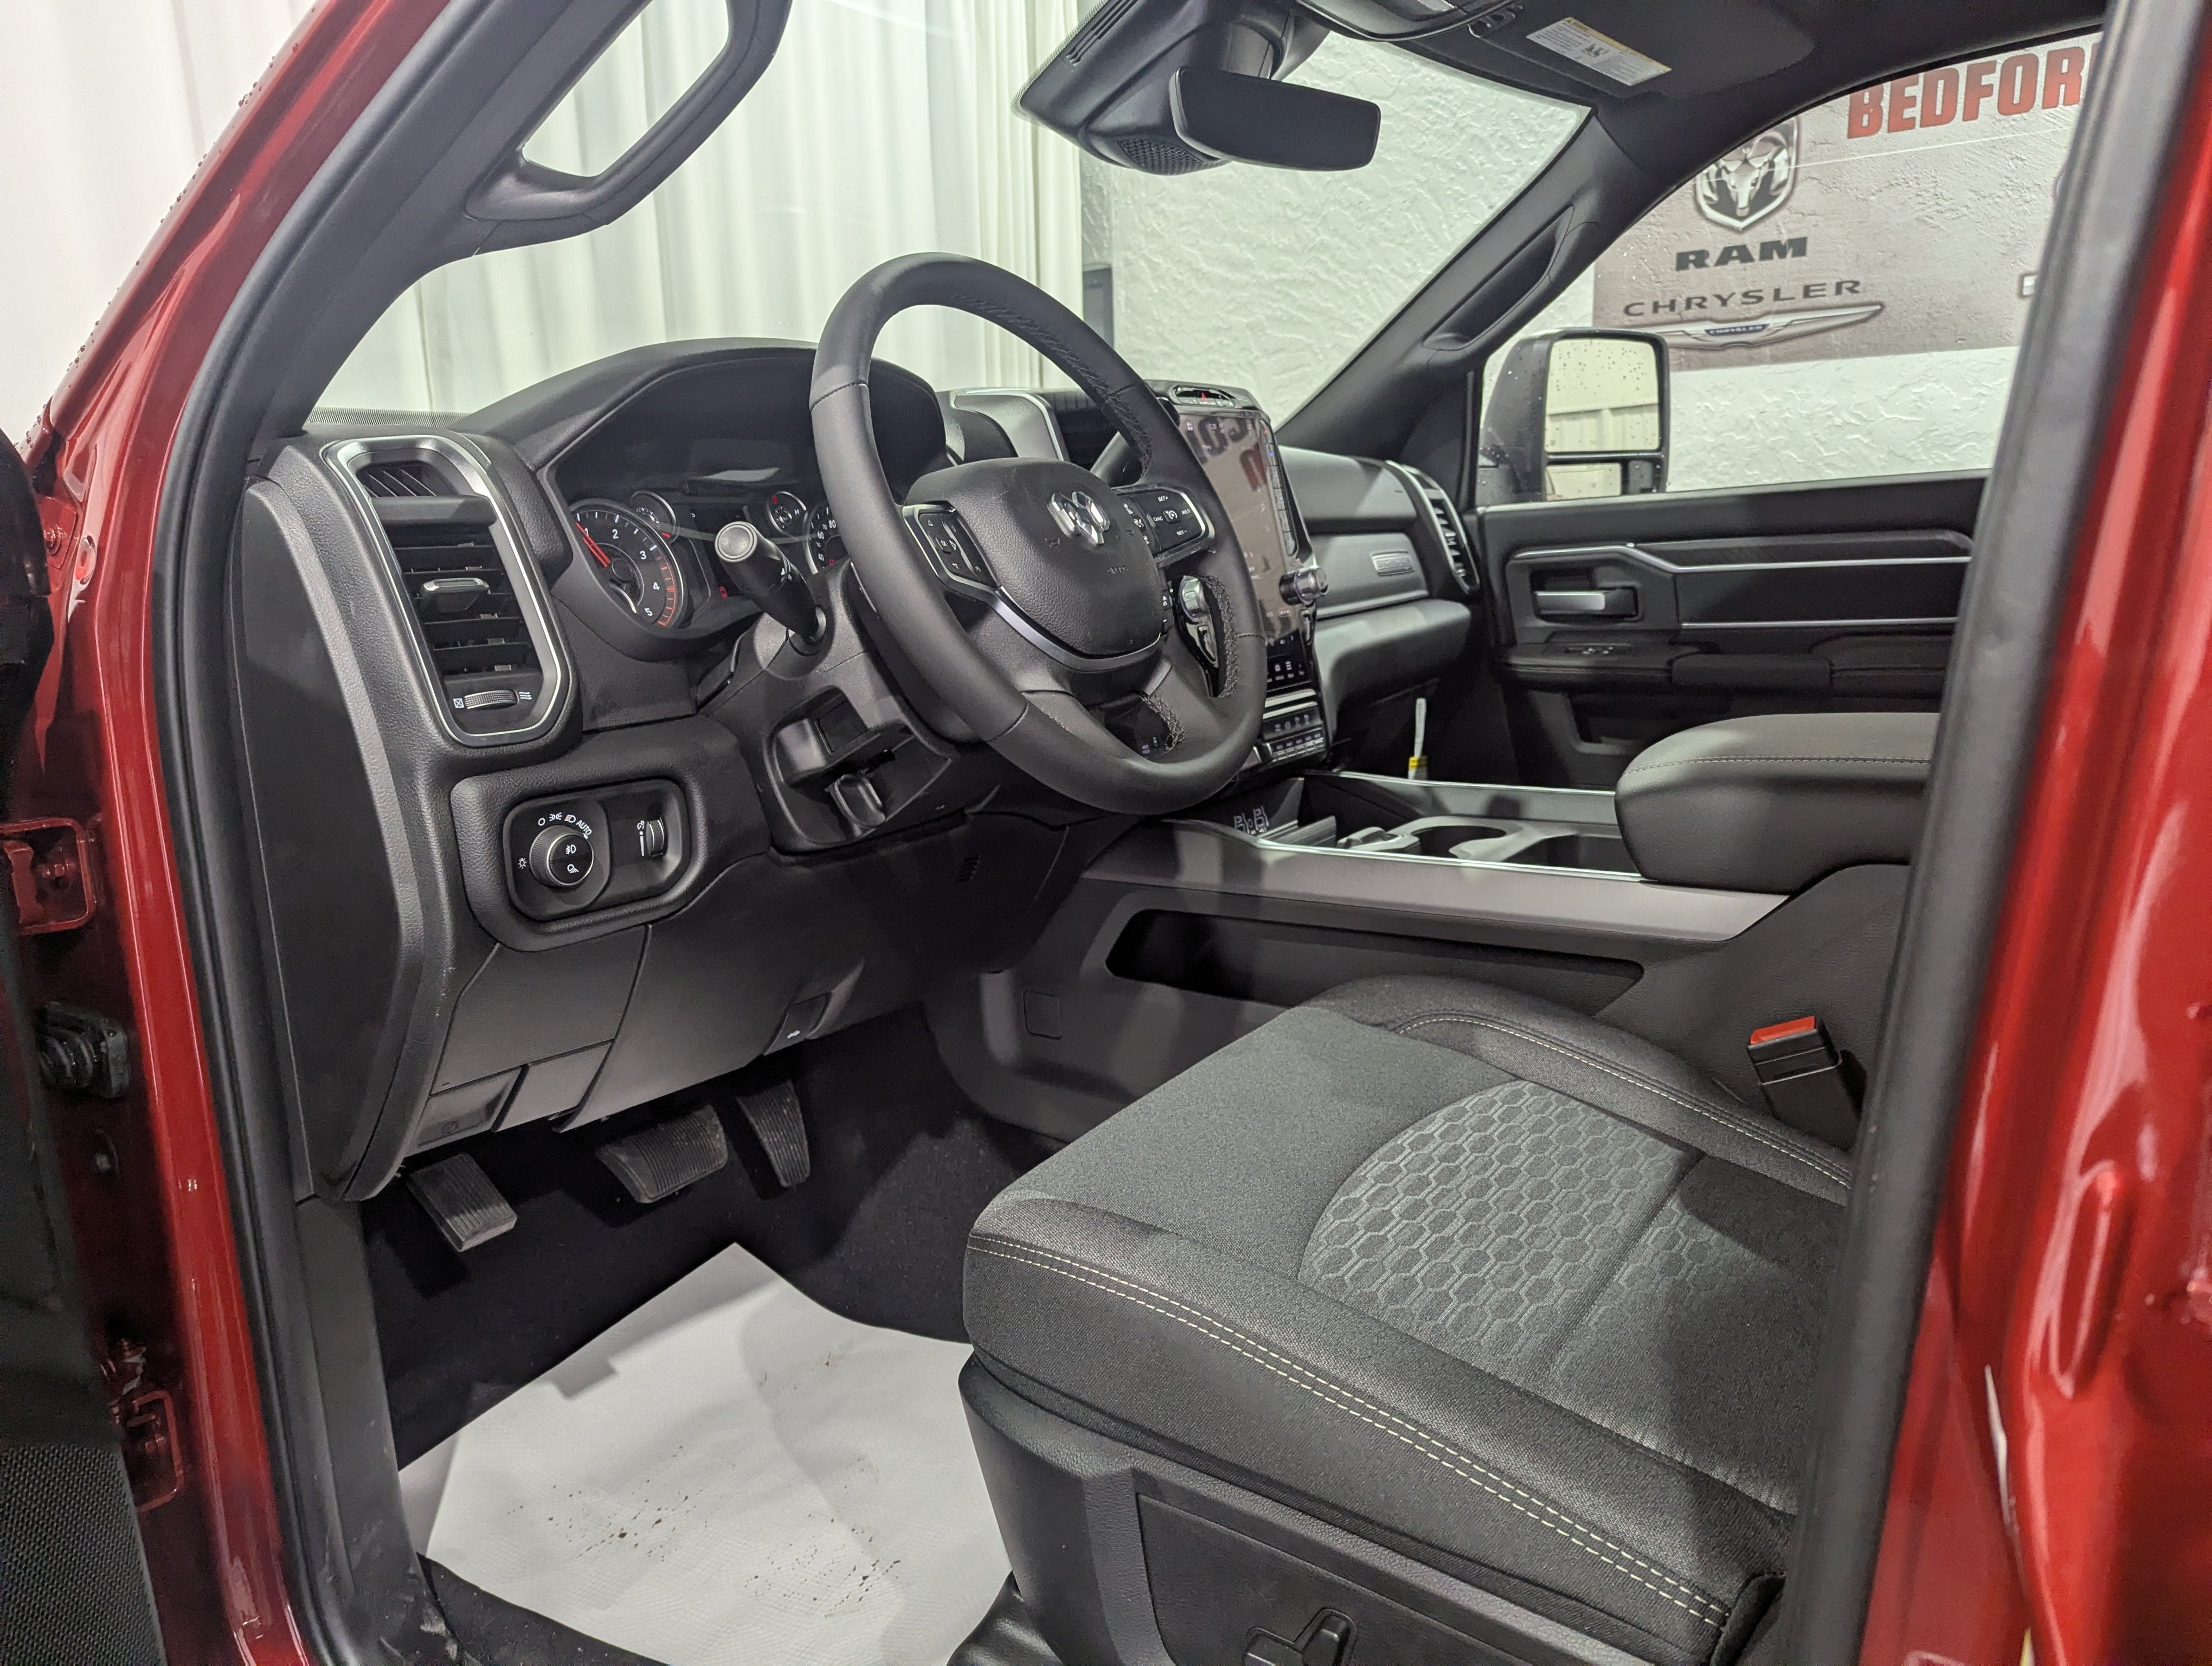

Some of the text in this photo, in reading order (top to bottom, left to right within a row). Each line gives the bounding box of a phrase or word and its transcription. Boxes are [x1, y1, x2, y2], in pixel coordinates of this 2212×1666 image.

[1847, 42, 2104, 139] BEDFOR
[1676, 236, 1808, 271] RAM
[1623, 279, 1861, 317] CHRYSLER
[828, 520, 837, 529] 80
[612, 529, 619, 539] 2
[817, 531, 825, 540] 60
[639, 550, 647, 560] 3
[652, 581, 660, 591] 4
[644, 607, 653, 617] 5
[576, 819, 592, 835] AUTO
